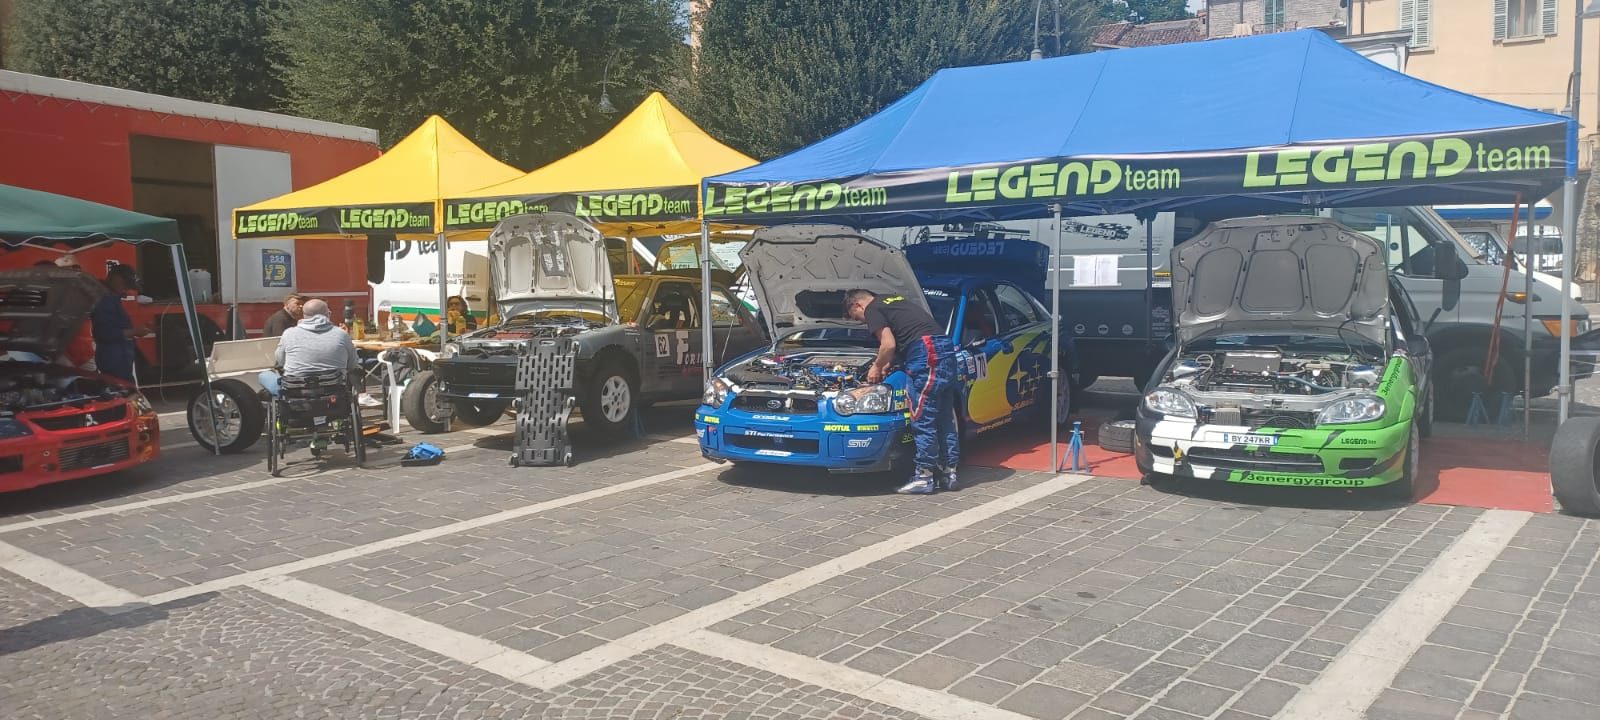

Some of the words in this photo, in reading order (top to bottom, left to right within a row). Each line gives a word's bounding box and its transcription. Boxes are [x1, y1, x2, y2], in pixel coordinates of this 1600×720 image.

[1243, 137, 1472, 188] LEGEND
[1476, 142, 1551, 173] team
[945, 160, 1122, 203] LEGEND
[1125, 164, 1180, 191] team
[575, 193, 663, 217] LEGEND
[664, 196, 691, 214] team
[703, 182, 842, 216] LEGEND
[843, 185, 887, 208] team
[238, 212, 299, 234] LEGEND
[299, 215, 318, 229] team
[340, 208, 409, 229] LEGEND
[409, 212, 430, 227] team
[446, 200, 524, 225] LEGEND
[823, 424, 851, 432] MOTUL
[1231, 435, 1243, 443] BY
[1243, 436, 1271, 445] 247KR
